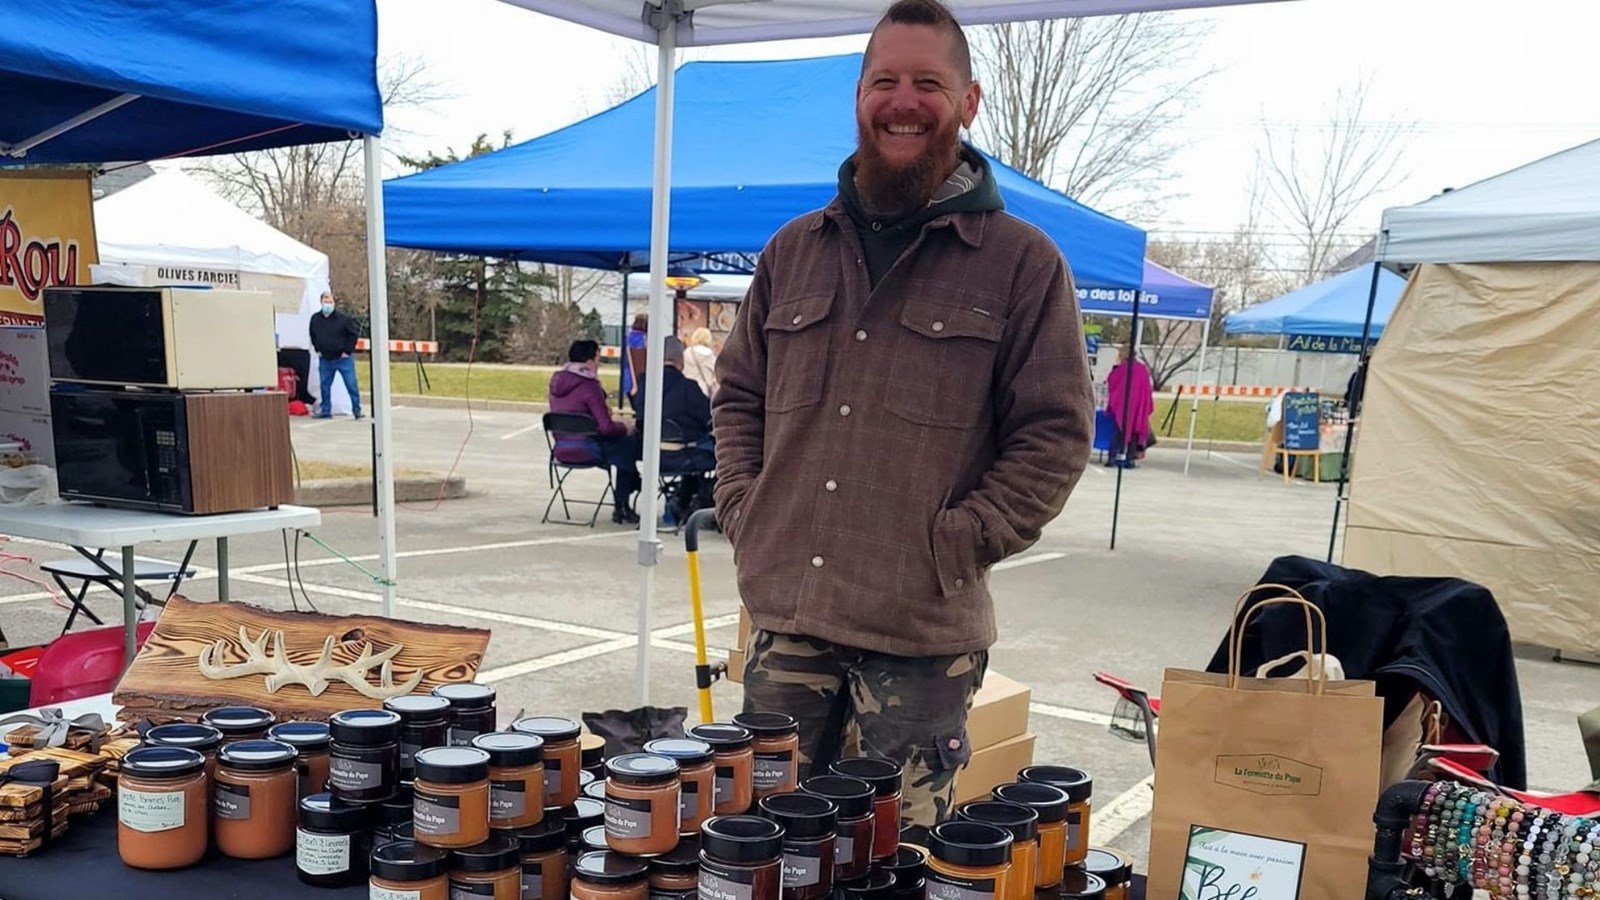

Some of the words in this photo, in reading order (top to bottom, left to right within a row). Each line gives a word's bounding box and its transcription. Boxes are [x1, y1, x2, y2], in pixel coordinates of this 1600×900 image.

[157, 267, 195, 281] OLIVES
[1090, 288, 1115, 301] des
[1118, 289, 1159, 305] loiirs
[1234, 767, 1243, 775] La
[1200, 842, 1213, 852] Fait
[1221, 845, 1229, 854] la
[1230, 849, 1248, 859] main
[1249, 852, 1265, 861] avec
[1265, 856, 1295, 867] passion
[791, 866, 807, 875] Pape
